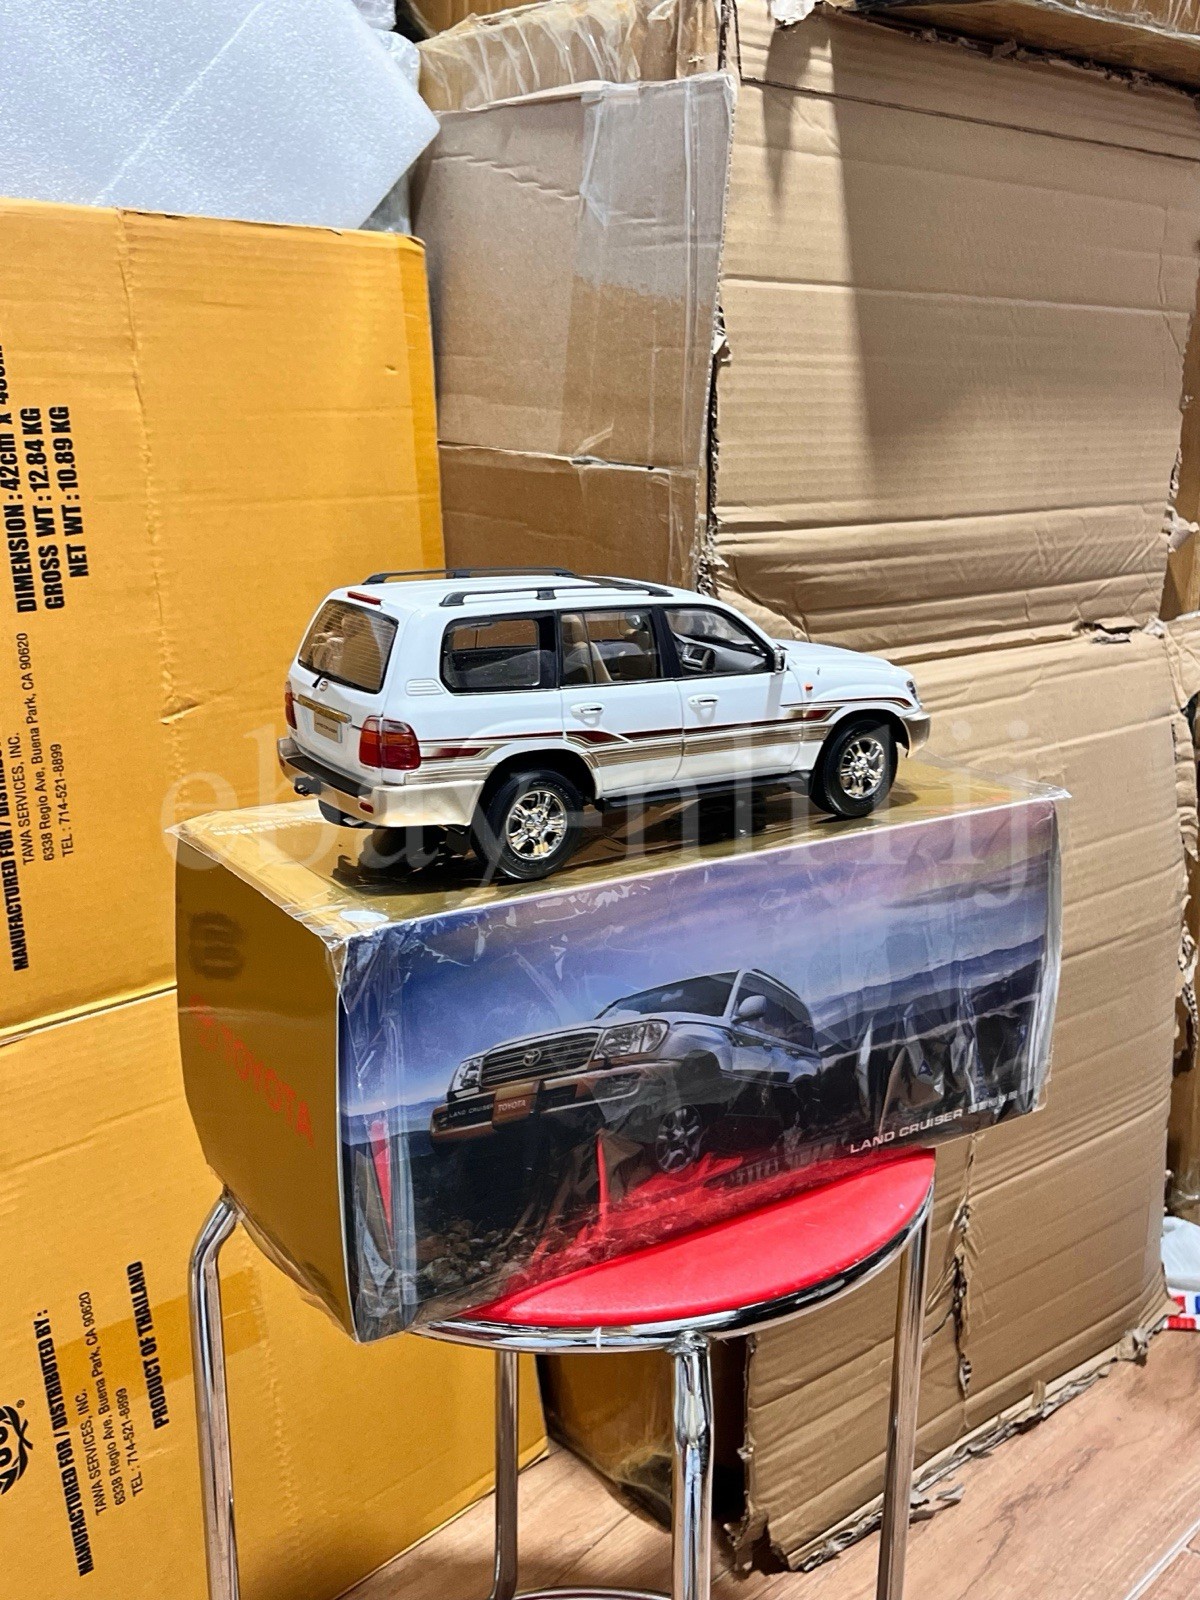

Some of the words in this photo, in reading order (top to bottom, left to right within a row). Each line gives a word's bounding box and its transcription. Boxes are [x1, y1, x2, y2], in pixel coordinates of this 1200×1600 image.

[20, 408, 43, 435] KG
[49, 406, 71, 433] KG
[0, 434, 20, 491] 42cm
[24, 439, 51, 493] 12.84
[52, 438, 79, 491] 10.89
[33, 505, 56, 538] WT
[61, 504, 84, 537] WT
[3, 504, 37, 613] DIMENSION
[66, 544, 89, 577] NET
[38, 544, 65, 609] GROSS
[16, 632, 31, 670] 90620
[22, 672, 34, 691] CA
[26, 693, 38, 724] Park,
[8, 732, 22, 759] INC.
[31, 727, 43, 764] Buena
[11, 761, 31, 828] SERVICES,
[35, 767, 47, 792] Ave,
[50, 743, 71, 825] 714-521-8899
[37, 795, 53, 830] Regio
[20, 829, 35, 865] TAWA
[41, 833, 55, 862] 6338
[61, 834, 73, 857] TEL
[1, 860, 29, 971] MANUFACTURED
[221, 1023, 316, 1150] TOYOTA
[498, 1100, 527, 1113] TOYOTA
[850, 1130, 894, 1153] LAND
[899, 1108, 963, 1138] CRUISER
[78, 1292, 94, 1327] 90620
[126, 1261, 154, 1337] THAILAND
[33, 1318, 52, 1339] BY
[85, 1327, 98, 1346] CA
[89, 1346, 103, 1378] Park,
[139, 1337, 158, 1357] OF
[38, 1337, 69, 1431] DISTRIBUTED
[75, 1388, 89, 1415] INC.
[96, 1378, 110, 1415] Buena
[142, 1357, 170, 1429] PRODUCT
[102, 1414, 115, 1441] Ave,
[116, 1387, 139, 1466] 714-521-8899
[56, 1438, 75, 1468] FOR
[80, 1414, 102, 1480] SERVICES,
[106, 1441, 121, 1476] Regio
[91, 1480, 107, 1516] TAWA
[111, 1476, 126, 1506] 6338
[131, 1471, 144, 1497] TEL
[62, 1466, 94, 1577] MANUFACTURED
